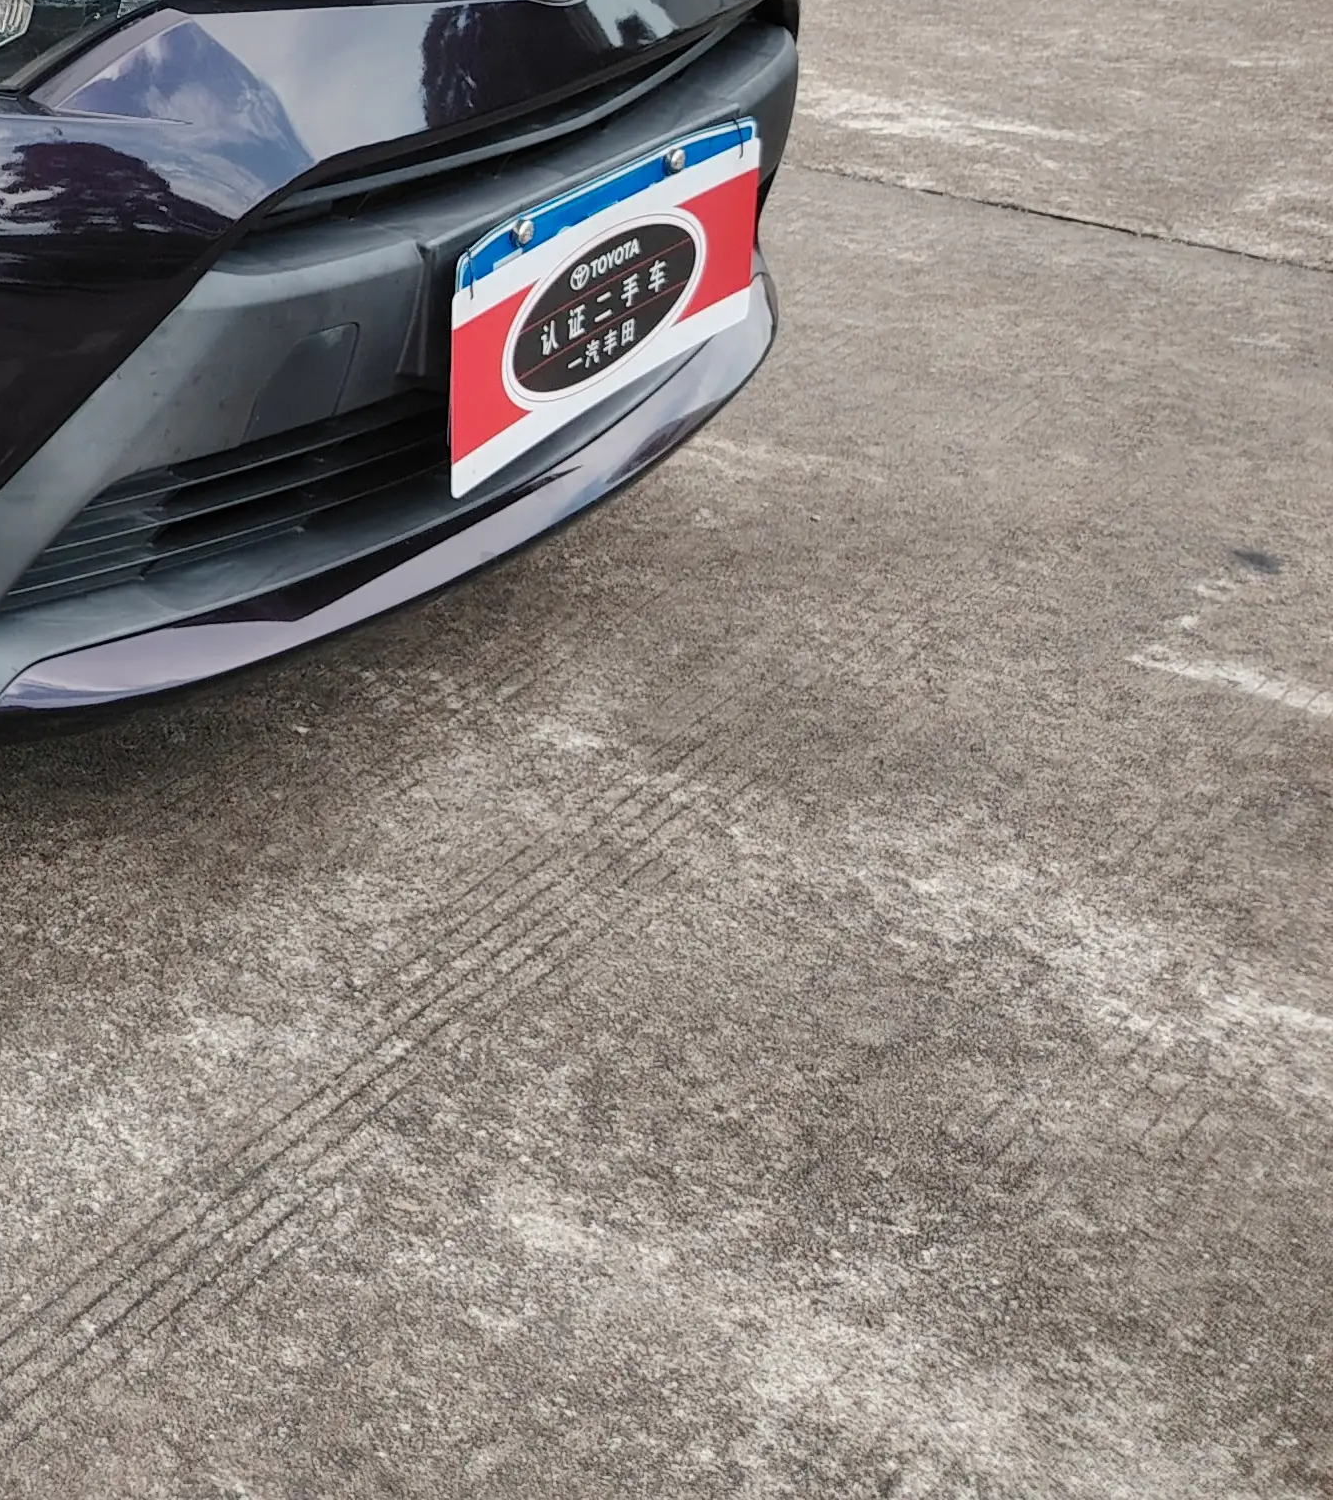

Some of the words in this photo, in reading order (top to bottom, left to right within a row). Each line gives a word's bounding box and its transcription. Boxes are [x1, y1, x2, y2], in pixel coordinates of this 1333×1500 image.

[589, 238, 640, 278] TOYOTA
[540, 259, 668, 357] 认证二手车
[566, 317, 637, 369] 一汽丰田
